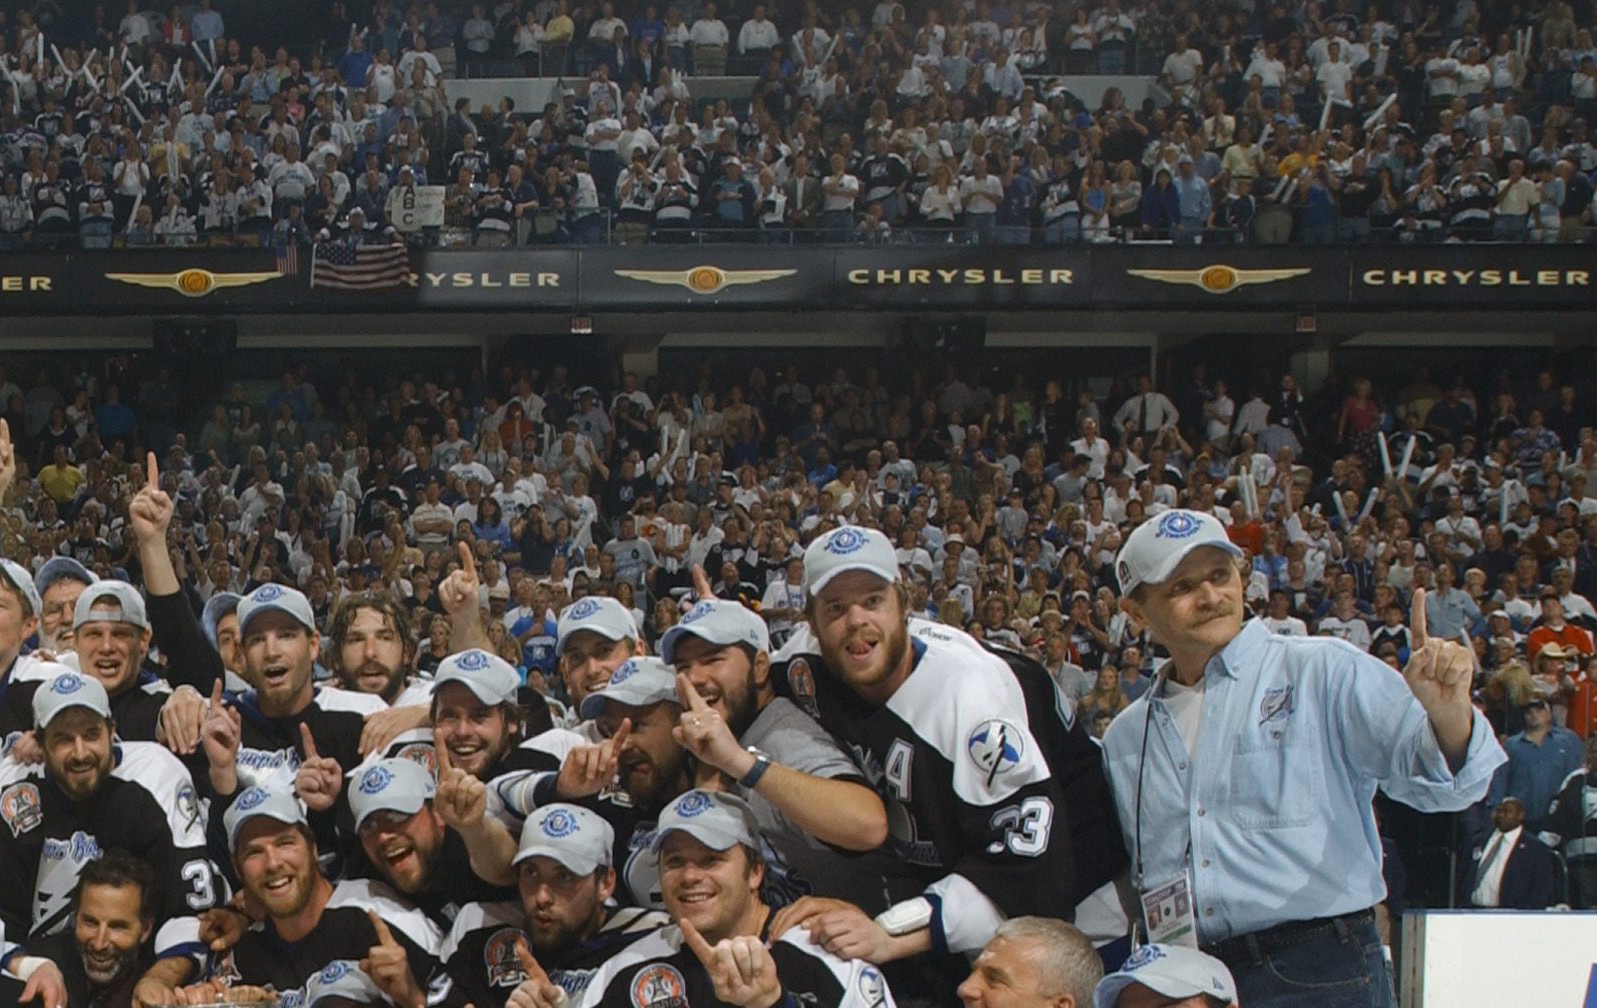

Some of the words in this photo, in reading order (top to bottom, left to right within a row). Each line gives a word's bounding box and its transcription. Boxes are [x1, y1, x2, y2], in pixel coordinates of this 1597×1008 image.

[848, 268, 1073, 284] CHRYSLER
[1363, 269, 1589, 285] CHRYSLER
[885, 736, 915, 804] A
